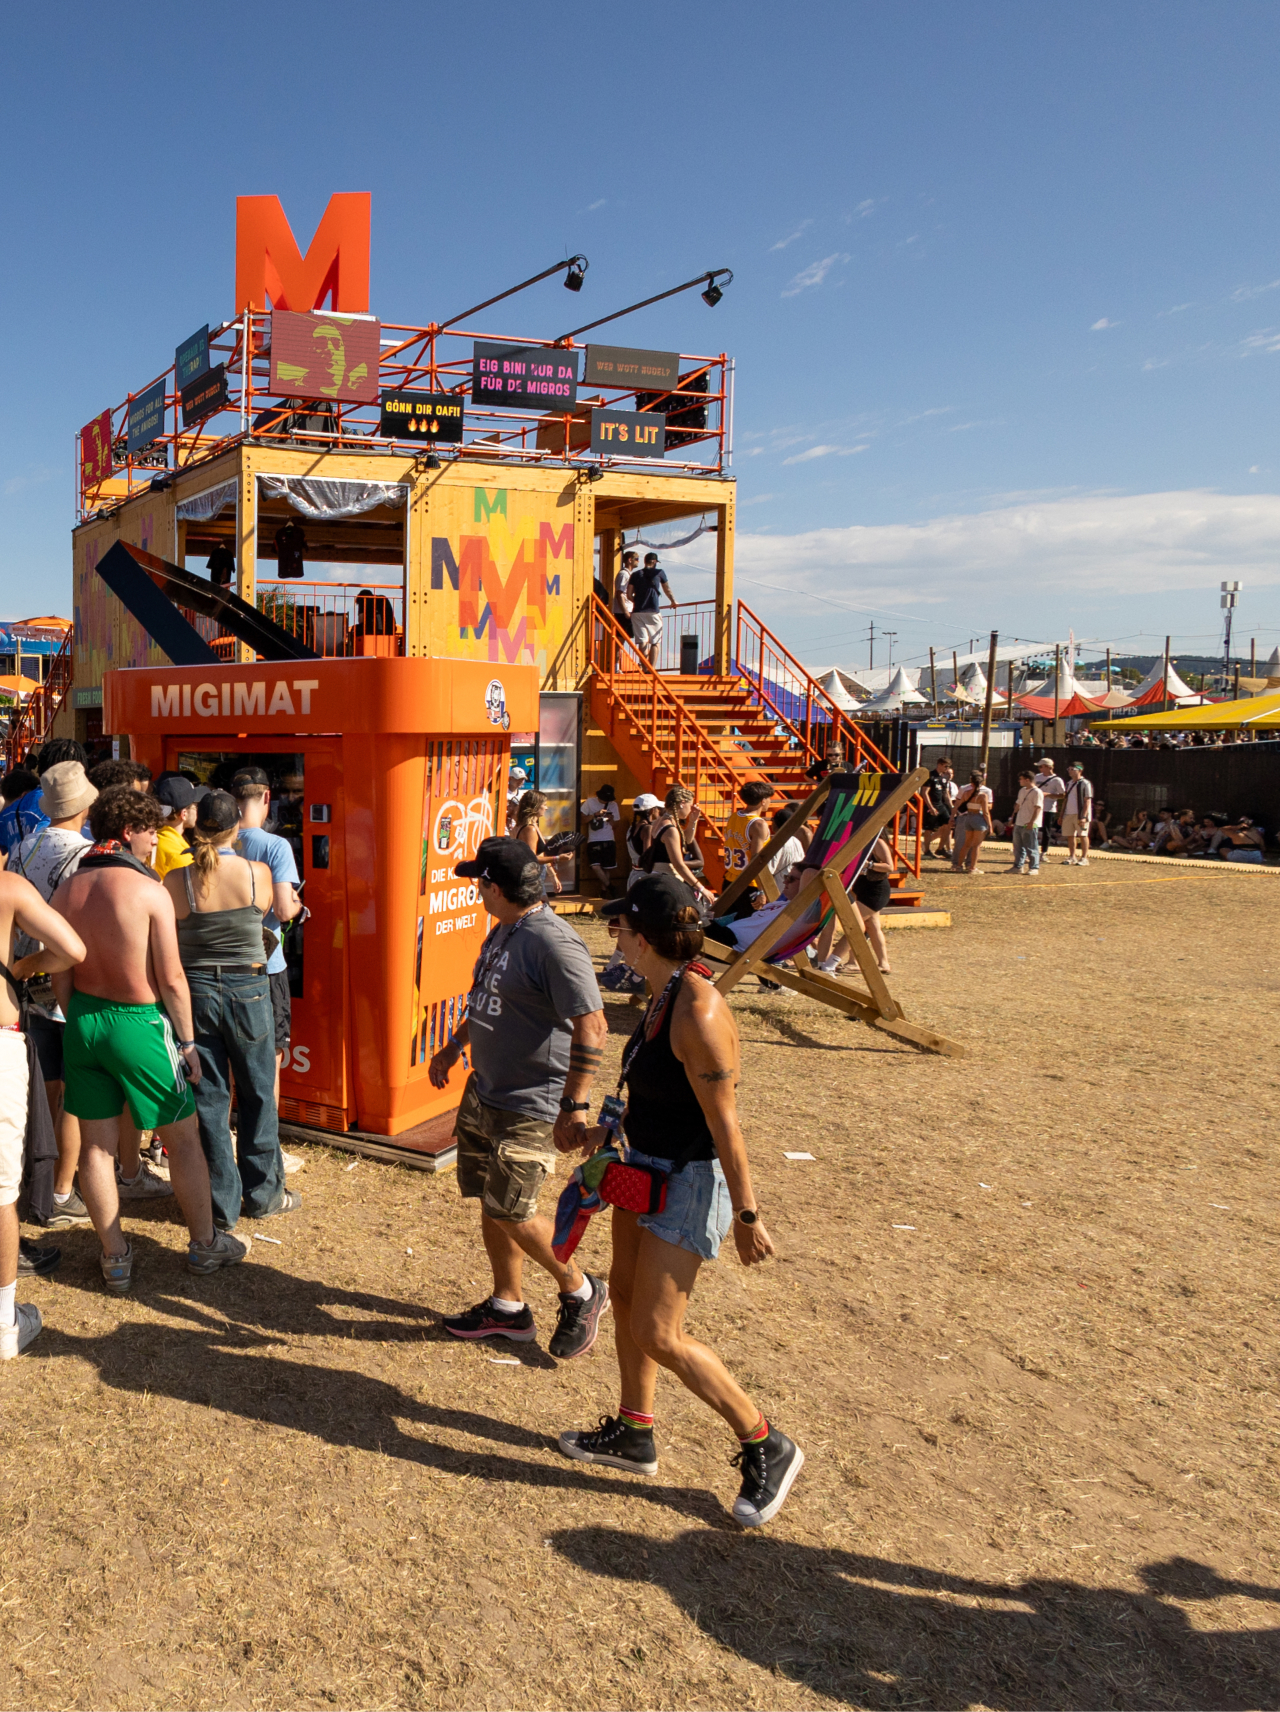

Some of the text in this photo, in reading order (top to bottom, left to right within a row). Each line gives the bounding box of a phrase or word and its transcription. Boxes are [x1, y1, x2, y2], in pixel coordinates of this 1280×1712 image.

[235, 191, 372, 313] M
[479, 359, 498, 372] EIG
[503, 361, 526, 376] BINI
[558, 366, 573, 380] DA
[596, 361, 613, 371] WER
[617, 363, 639, 373] WOTT
[480, 374, 571, 397] FÜR DE MIGROS
[385, 399, 412, 414] GÖNN
[416, 404, 432, 416] DIR
[600, 422, 659, 444] IT'S LIT
[474, 487, 507, 523] M
[539, 521, 573, 560] M
[151, 679, 319, 718] MIGIMAT
[431, 868, 446, 884] DIE
[436, 913, 477, 936] DER WELT
[469, 993, 502, 1016] LUB
